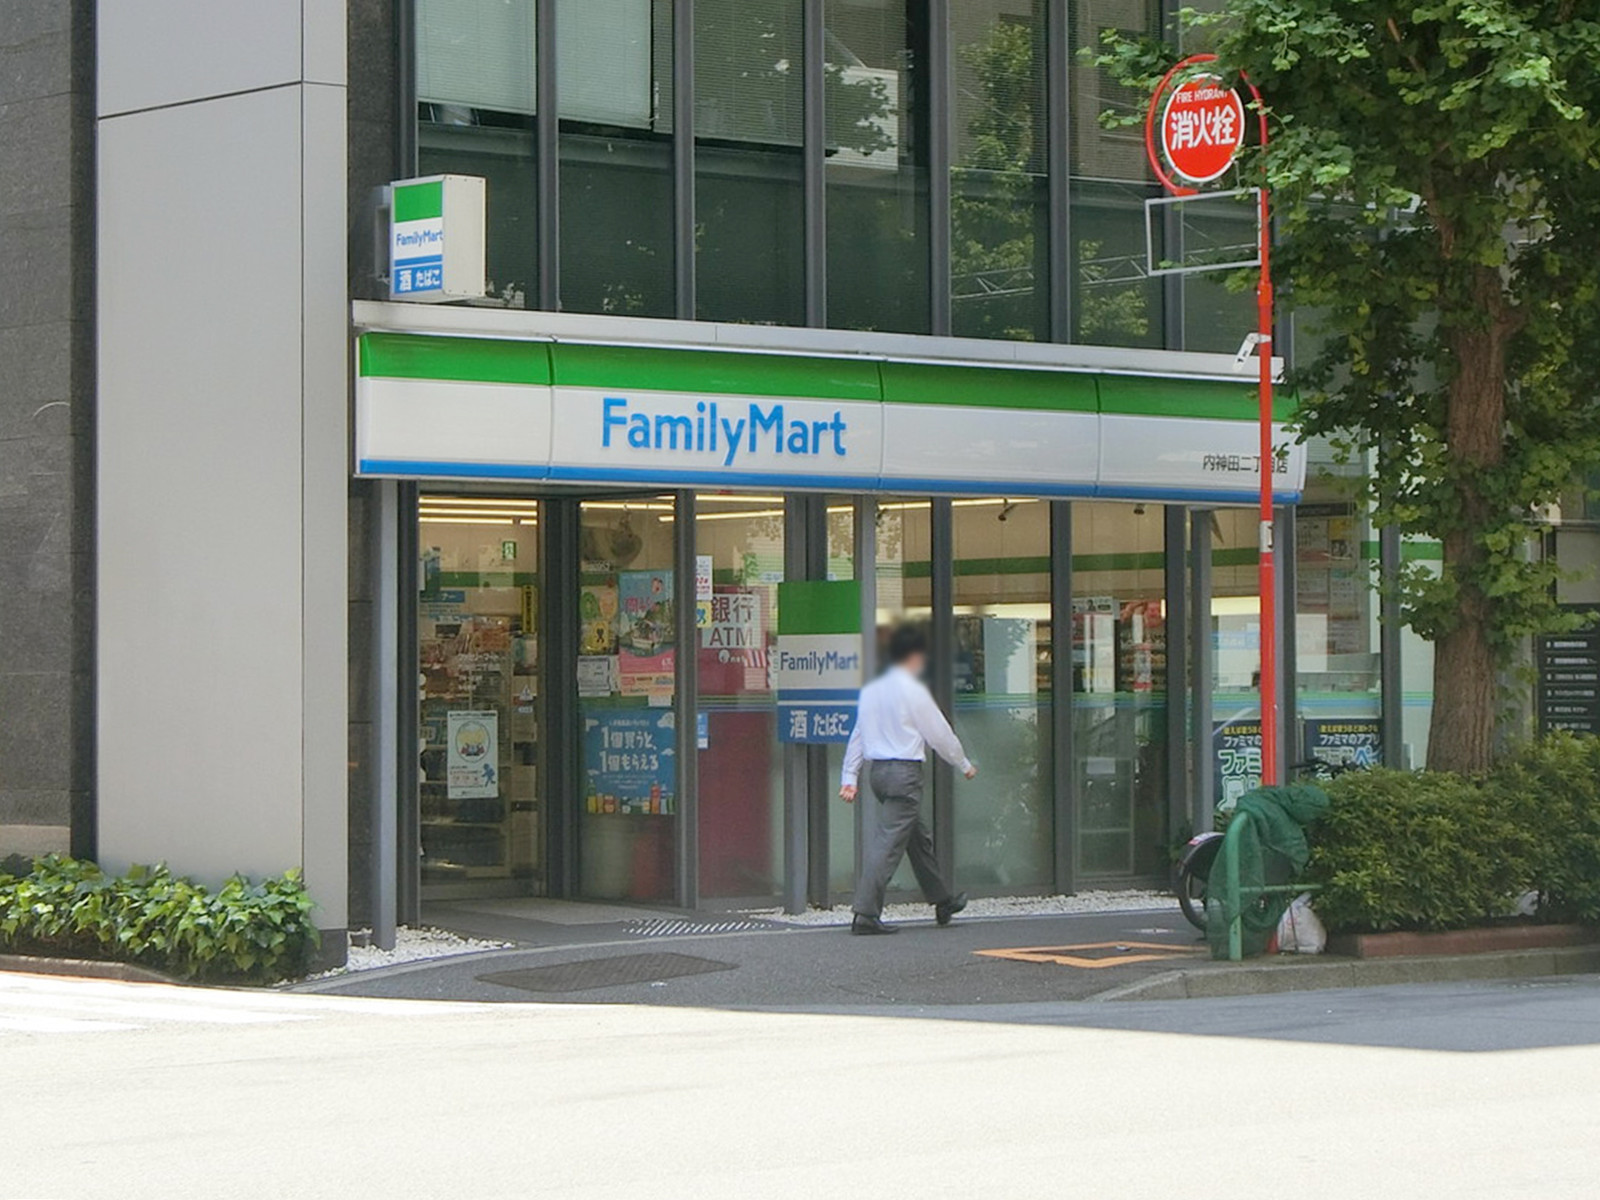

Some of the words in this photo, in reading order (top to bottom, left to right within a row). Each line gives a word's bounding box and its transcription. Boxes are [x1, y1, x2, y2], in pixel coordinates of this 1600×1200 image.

[1176, 91, 1193, 103] FIRE
[1171, 105, 1236, 150] 消火栓
[396, 229, 443, 247] FamilyMart
[399, 270, 412, 291] 酒
[415, 269, 441, 288] たばこ
[602, 397, 846, 466] FamilyMart
[1203, 454, 1288, 474] 内神田二丁店
[711, 597, 754, 623] 銀行
[709, 627, 753, 646] ATM
[780, 651, 860, 675] FamilyMart
[790, 711, 807, 738] 酒
[813, 713, 849, 736] たばこ
[1320, 734, 1379, 745] ファミマのアプリ
[600, 750, 659, 773] 1個もらえる
